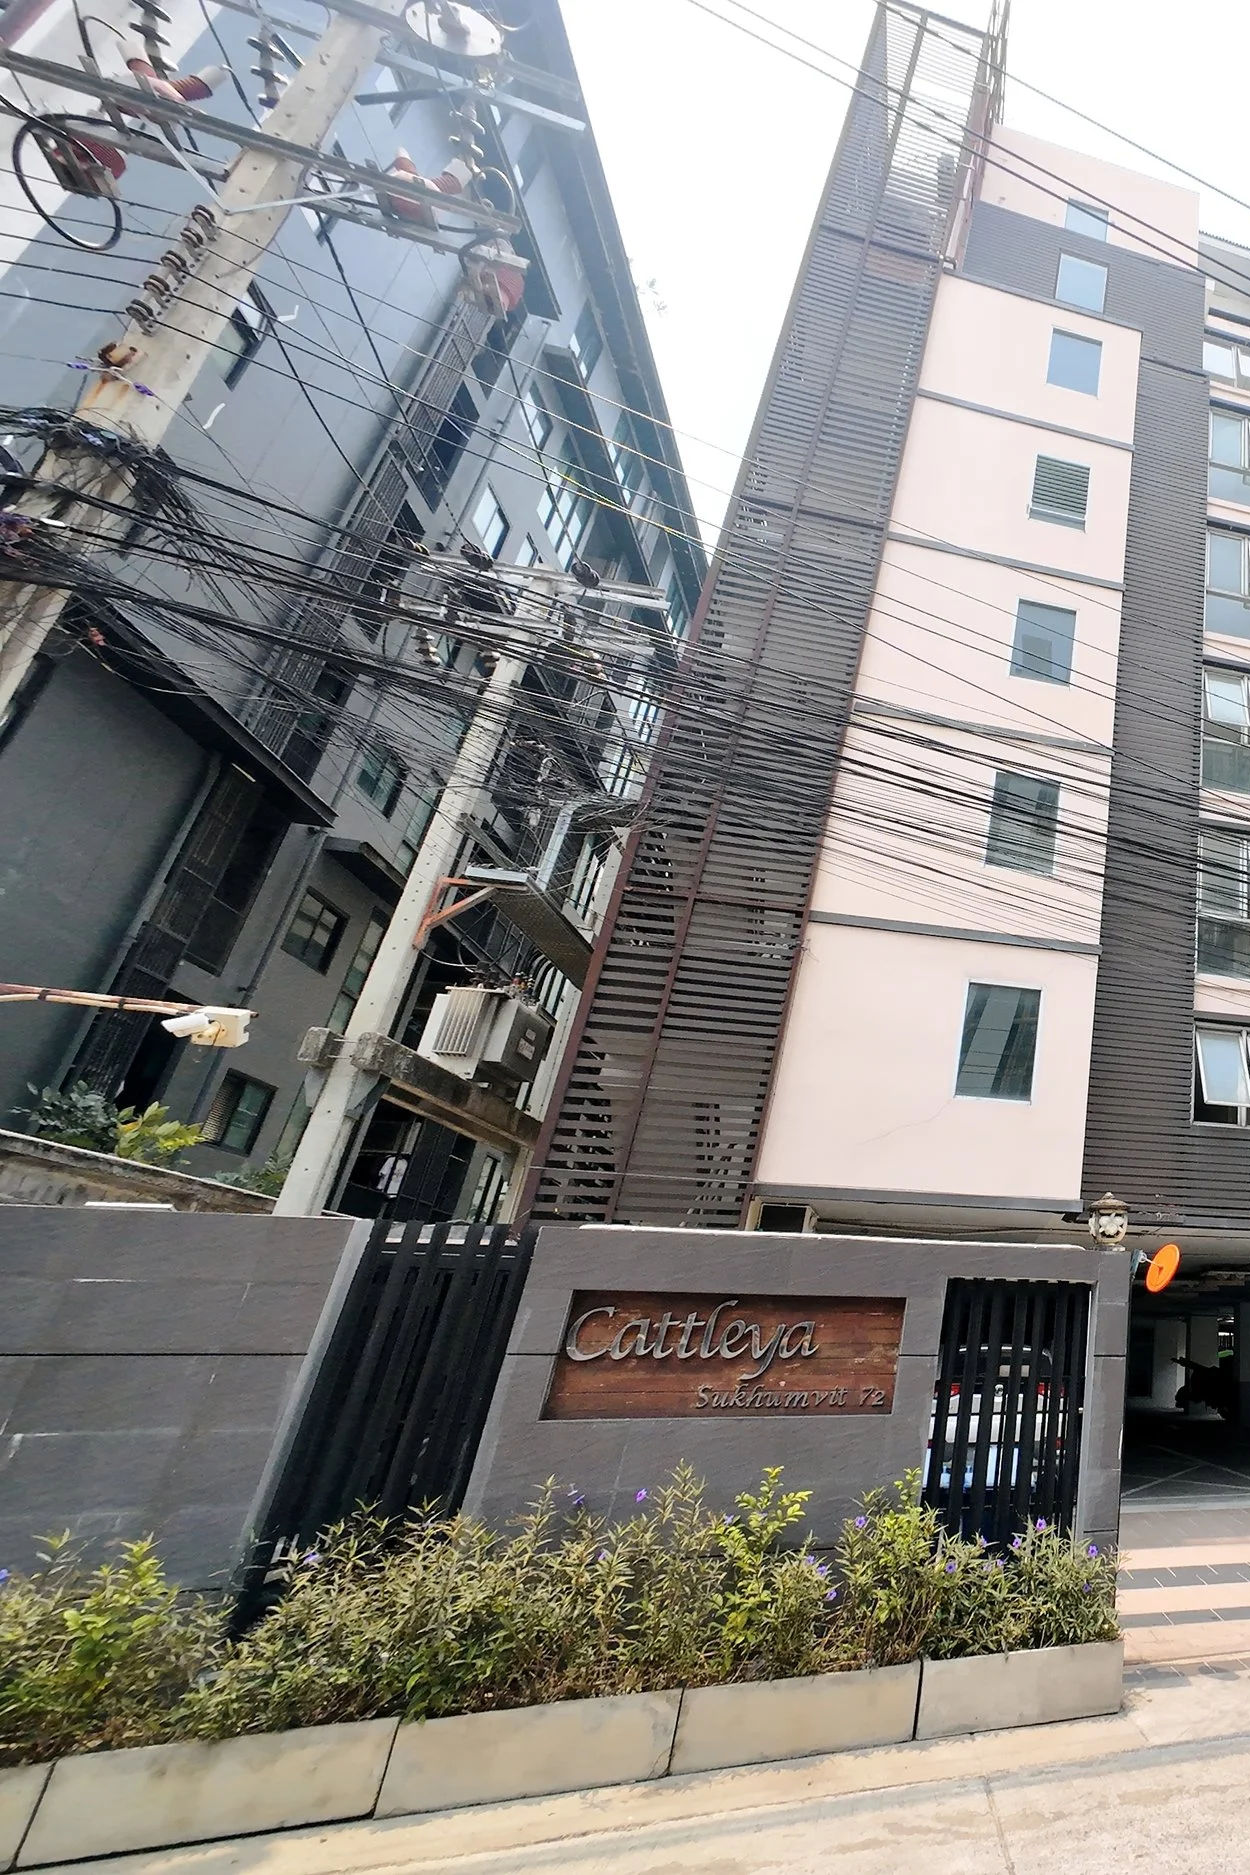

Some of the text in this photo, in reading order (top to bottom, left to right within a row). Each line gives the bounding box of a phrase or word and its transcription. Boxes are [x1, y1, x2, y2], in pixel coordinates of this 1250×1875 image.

[566, 1300, 819, 1380] Cattleya
[695, 1384, 885, 1408] Sukhumvit 72
